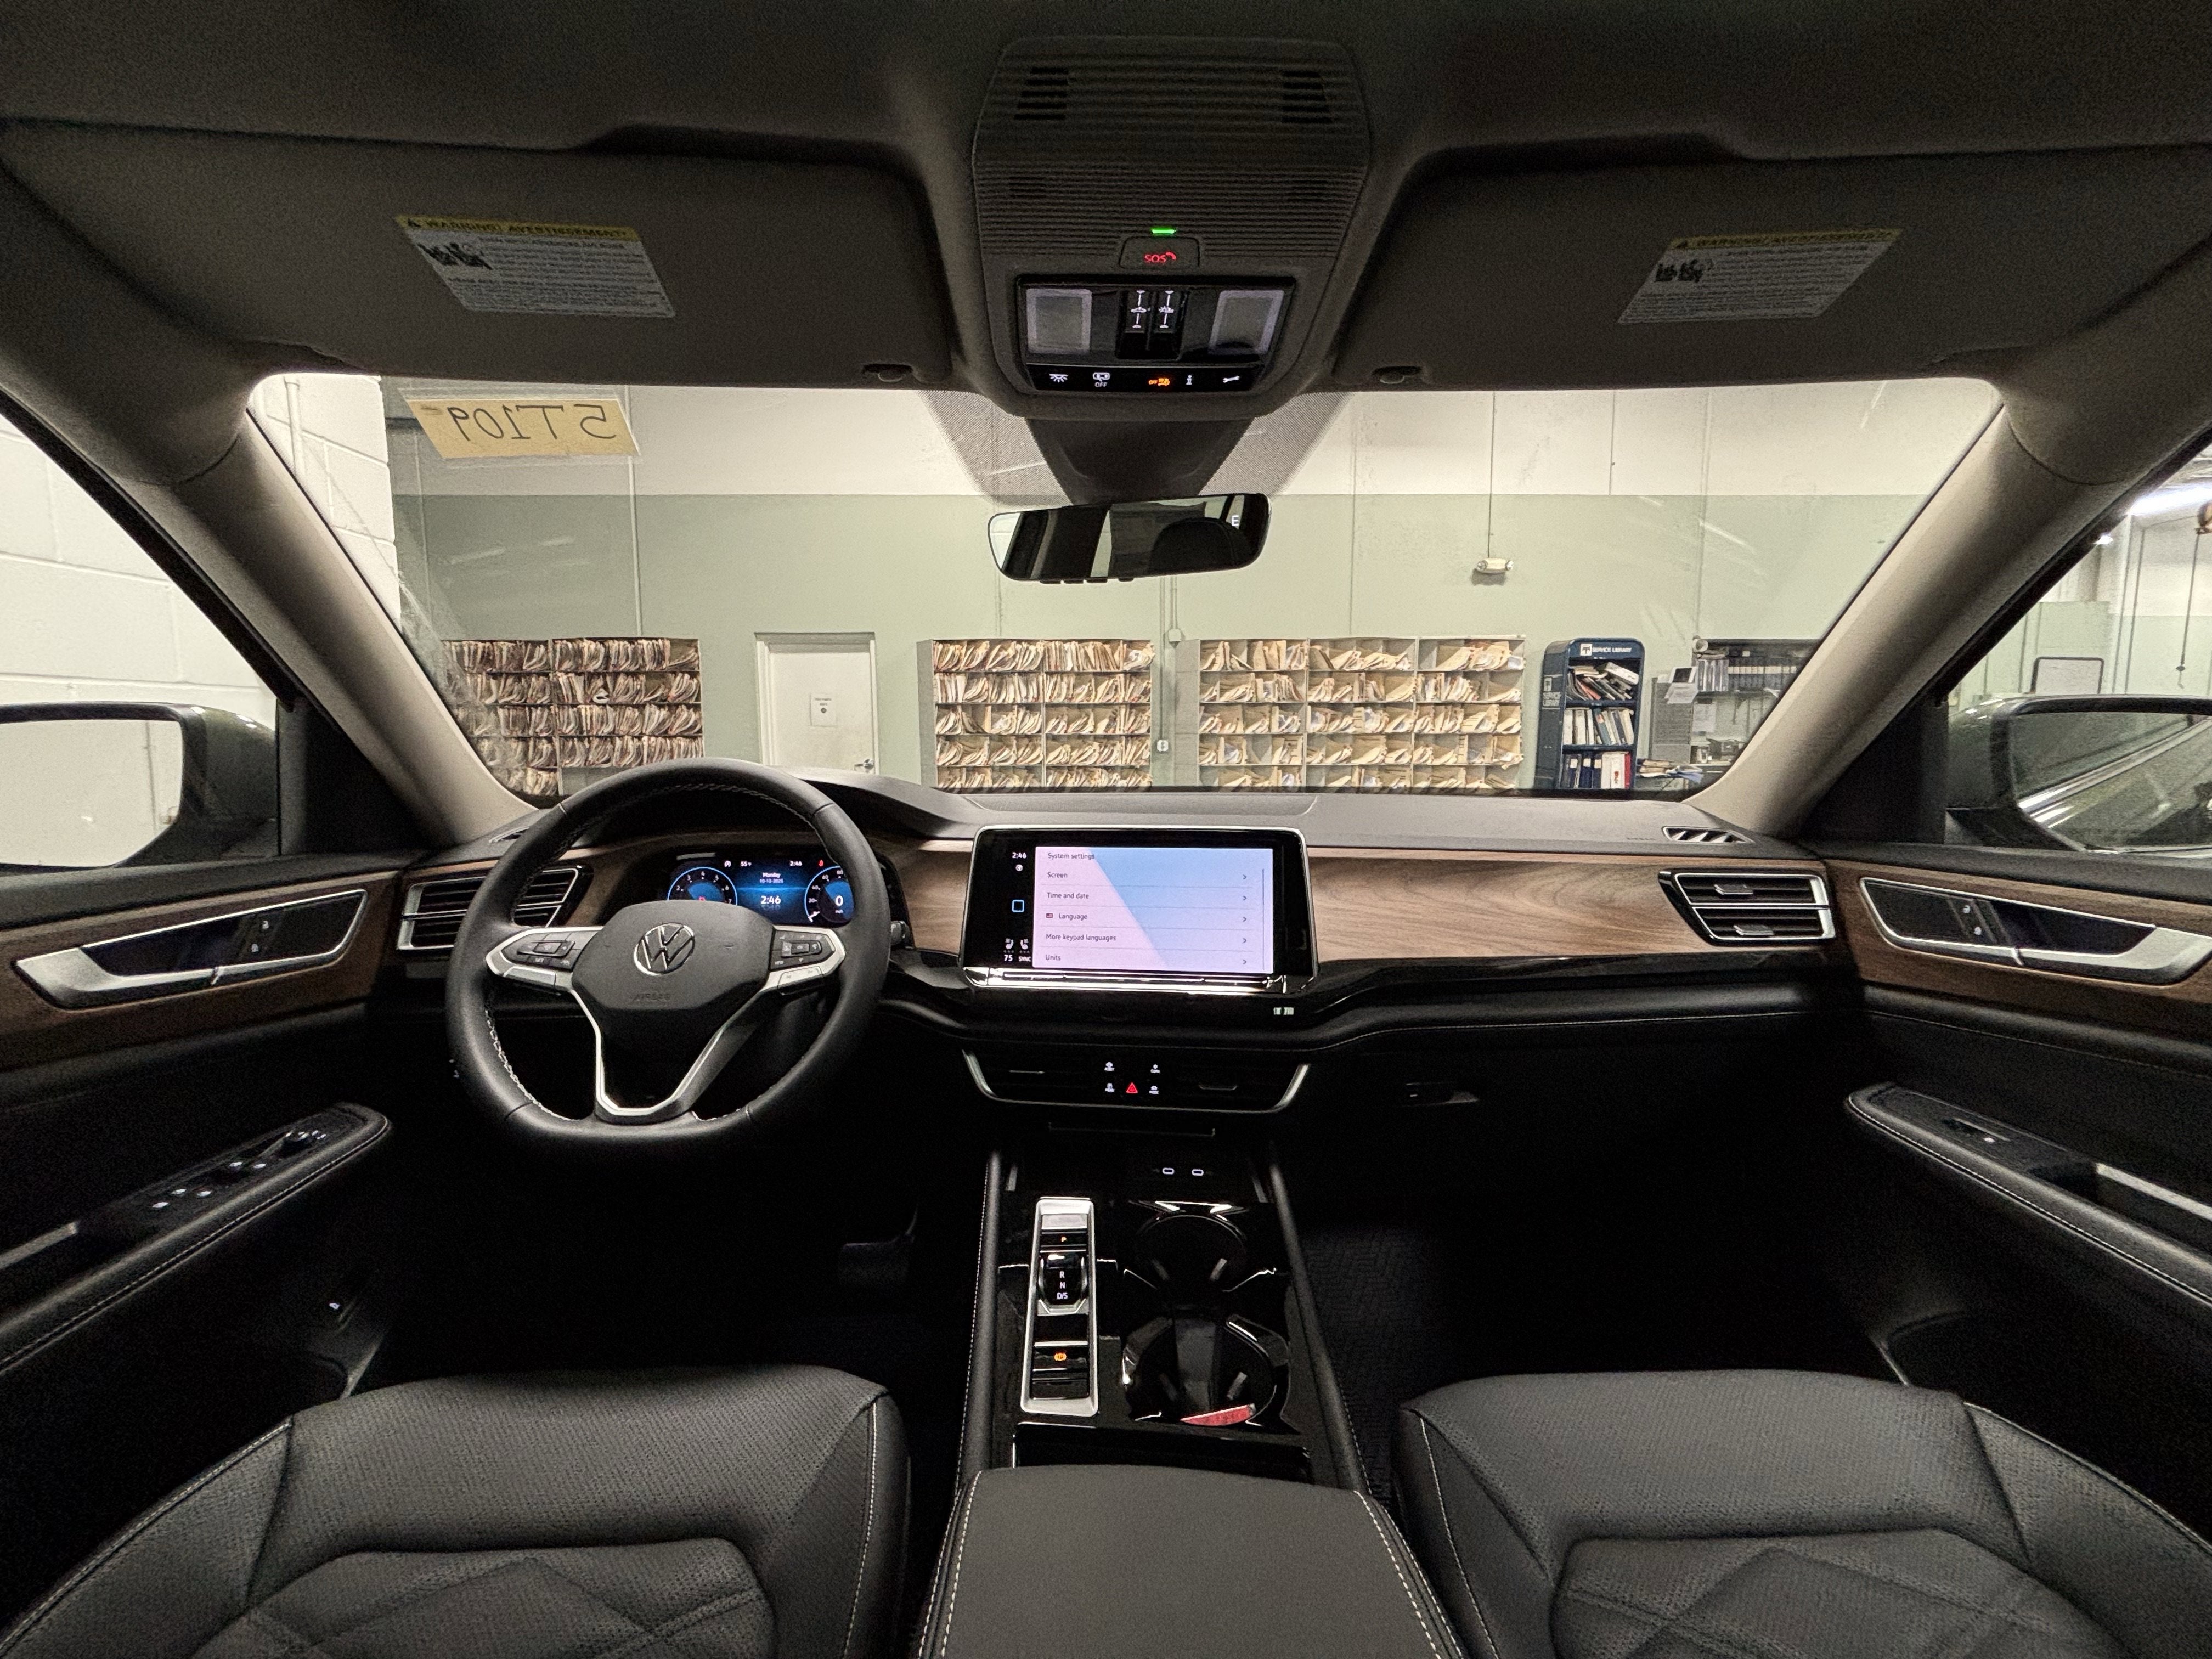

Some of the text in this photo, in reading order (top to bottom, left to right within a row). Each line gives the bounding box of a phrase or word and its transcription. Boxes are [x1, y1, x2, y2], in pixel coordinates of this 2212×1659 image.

[1144, 254, 1166, 263] SOS
[1232, 515, 1239, 527] E
[760, 895, 781, 904] 2:46
[836, 895, 844, 906] 0
[1058, 913, 1087, 921] Language
[1059, 1271, 1065, 1279] R
[1060, 1281, 1066, 1289] N
